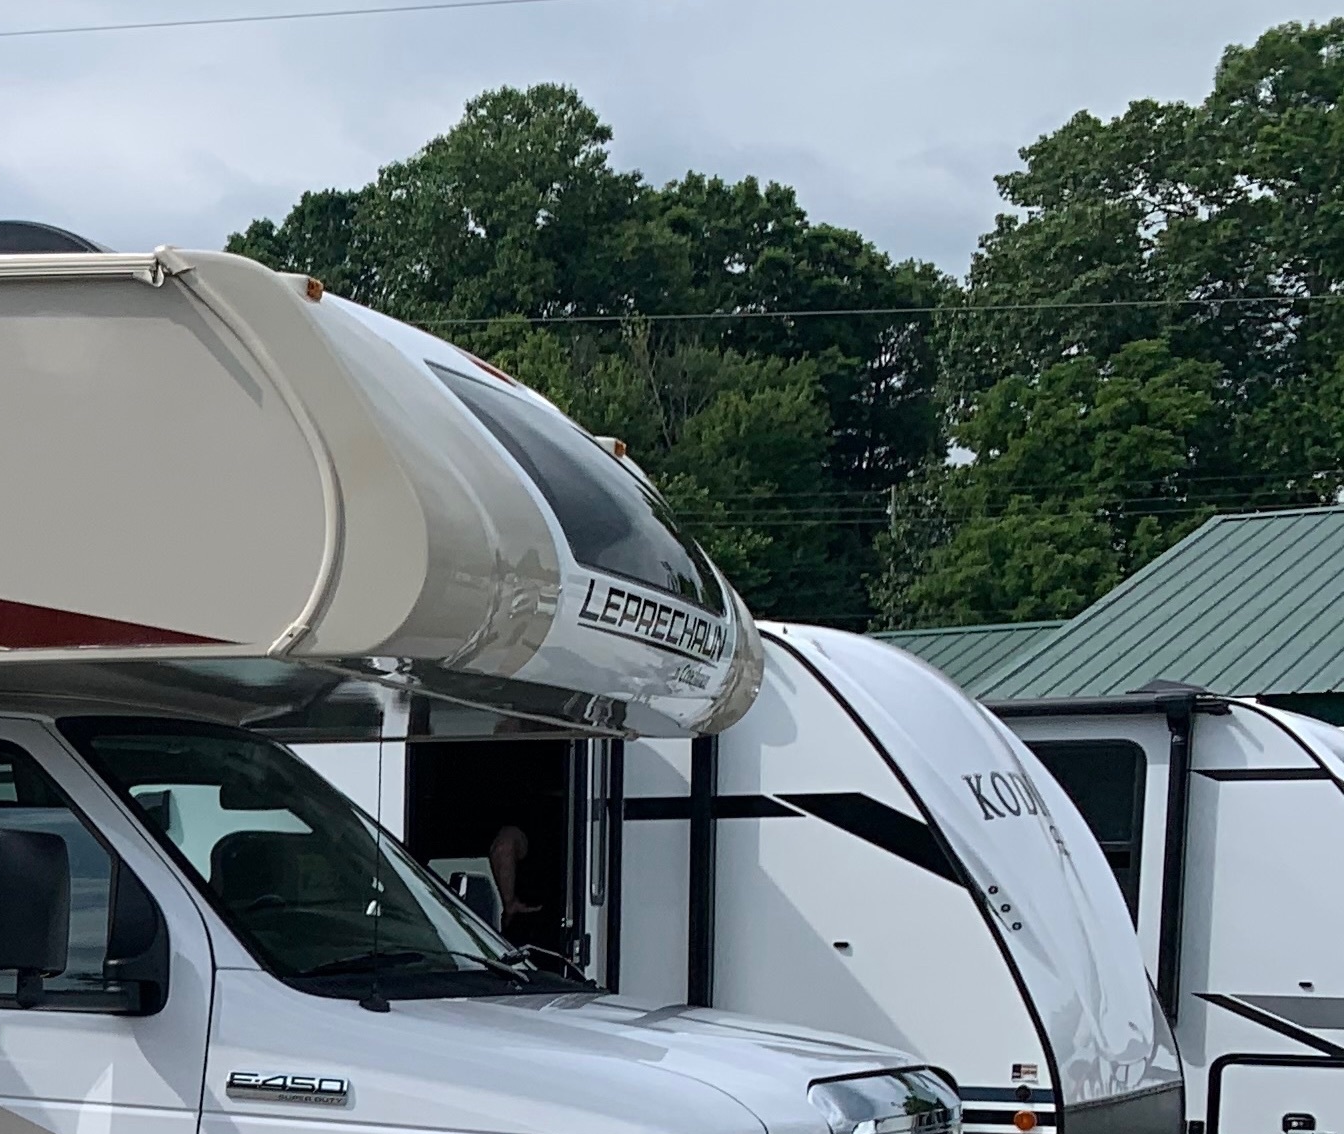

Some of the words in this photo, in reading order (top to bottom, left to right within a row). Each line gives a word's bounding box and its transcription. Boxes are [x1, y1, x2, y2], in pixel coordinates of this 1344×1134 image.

[579, 579, 728, 663] LEPRECHAUN
[278, 1093, 313, 1102] SUPER
[314, 1096, 343, 1104] DUTY
